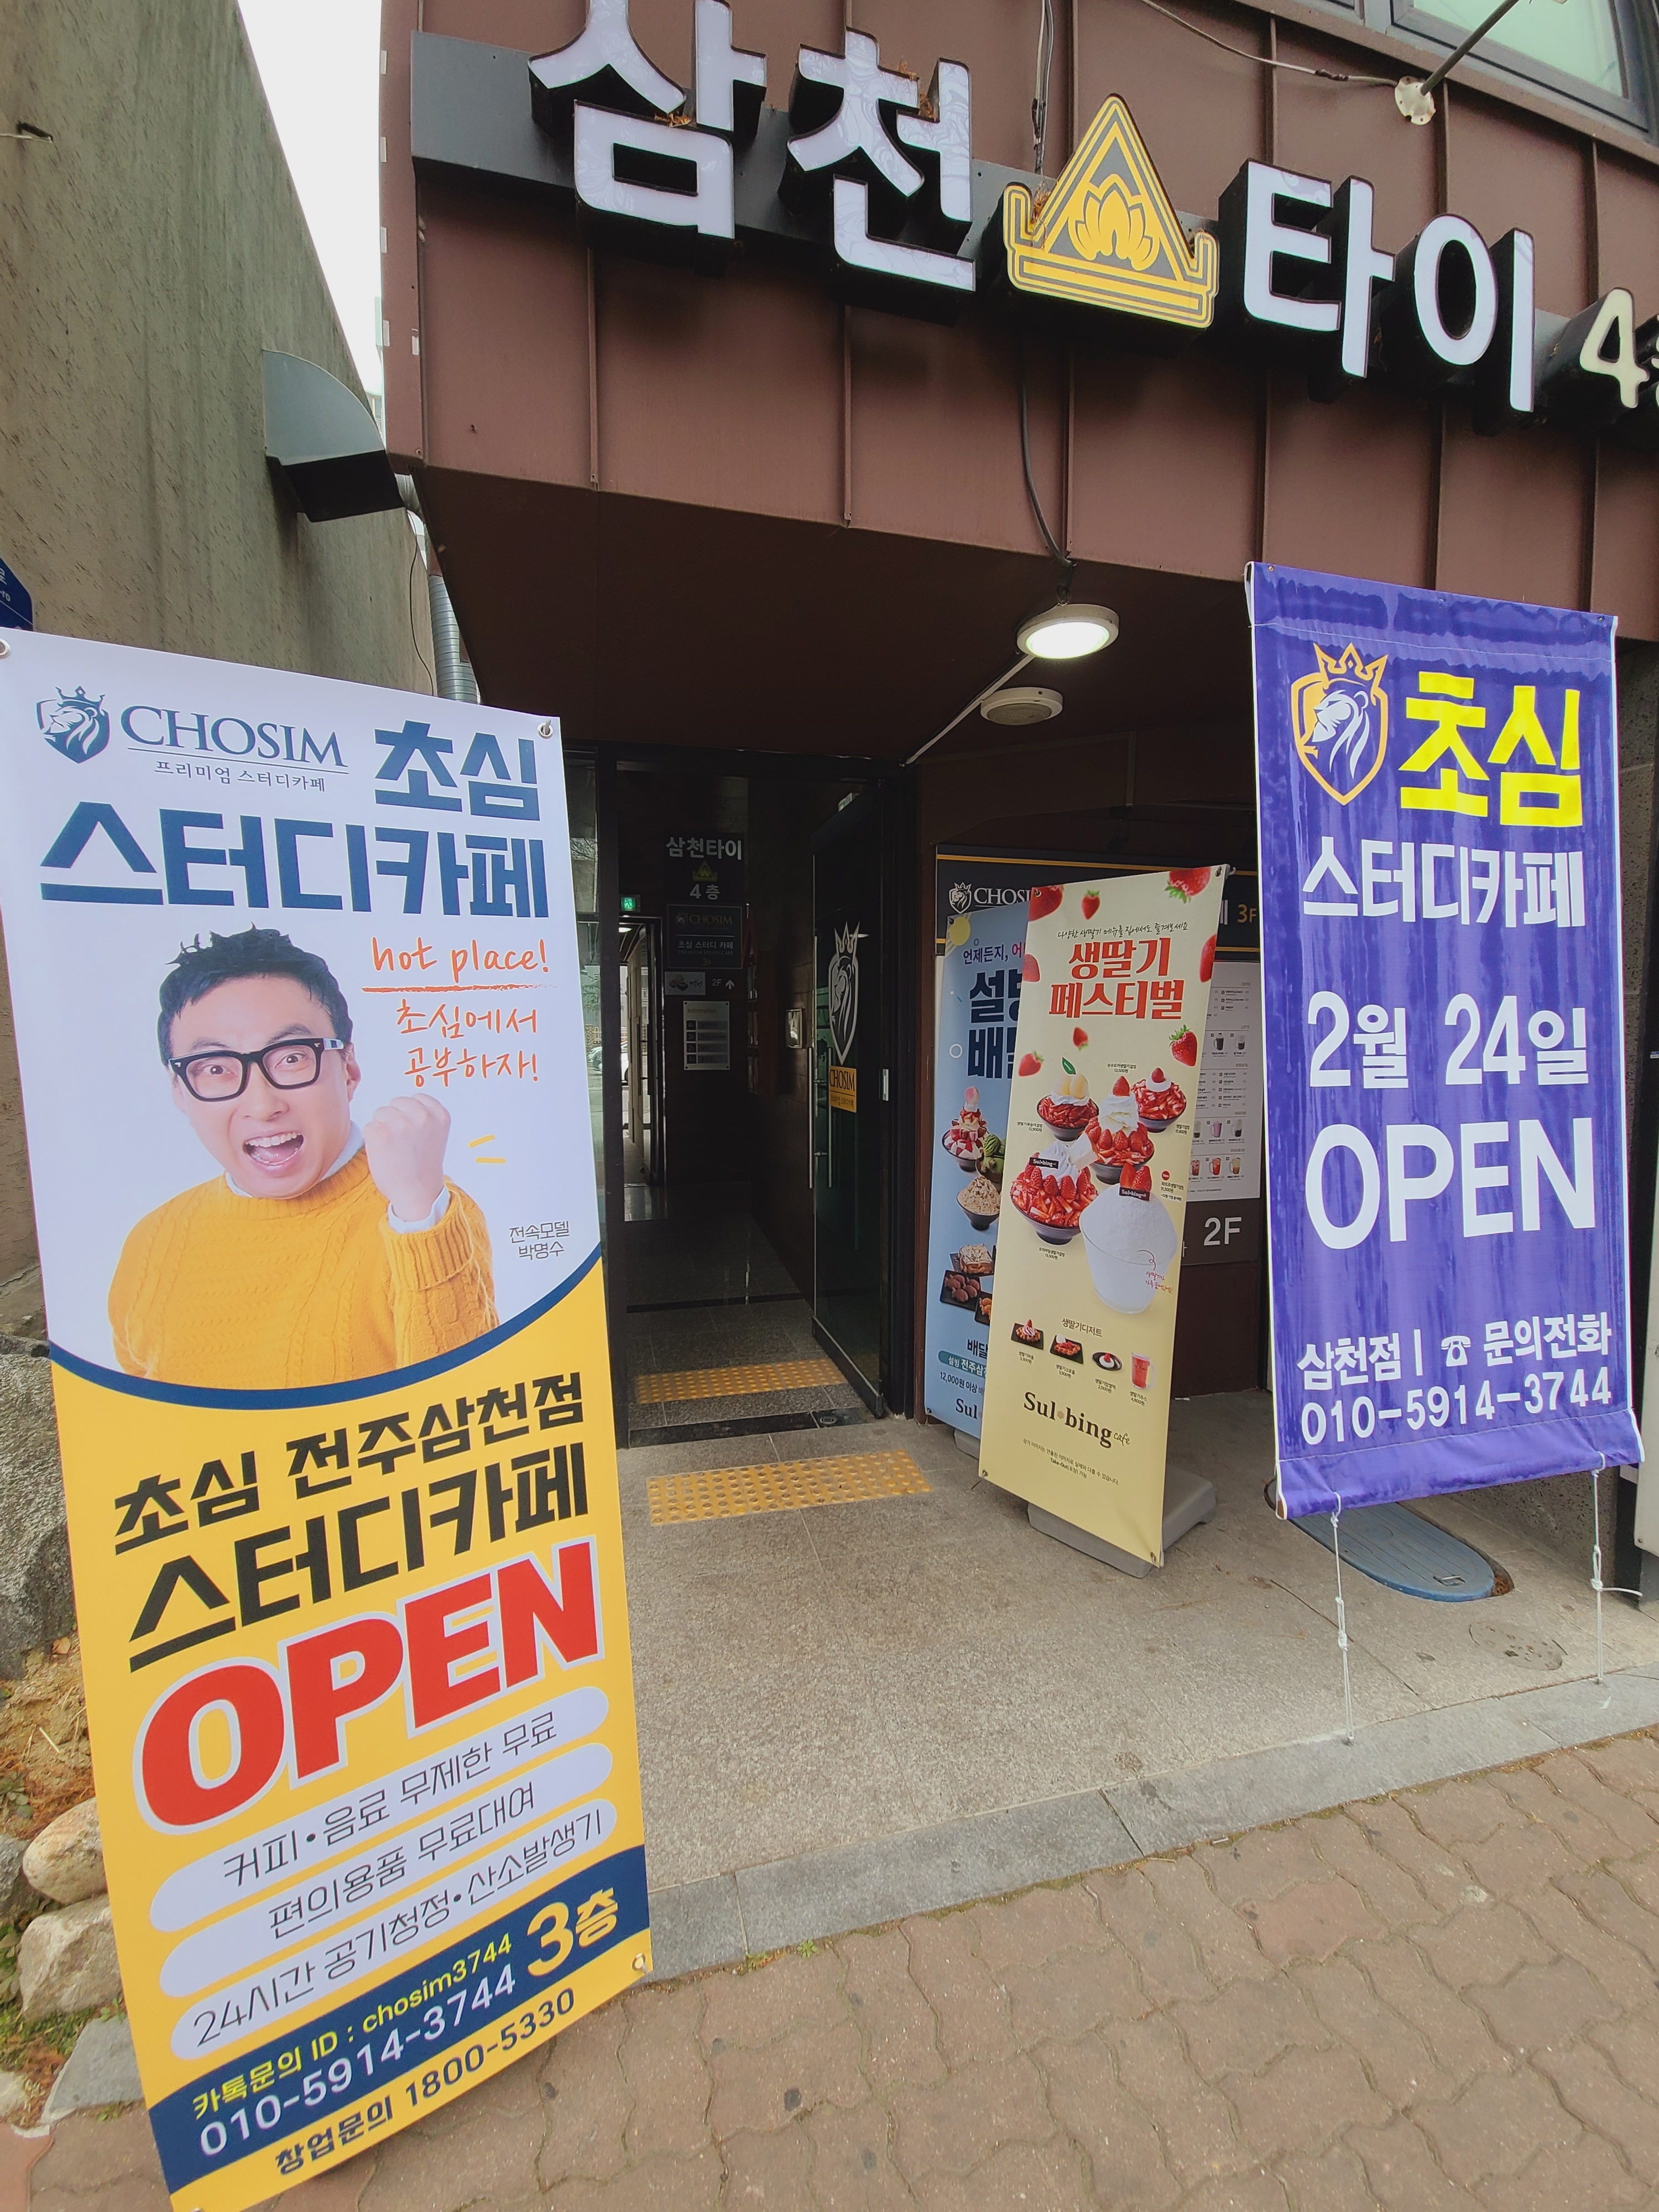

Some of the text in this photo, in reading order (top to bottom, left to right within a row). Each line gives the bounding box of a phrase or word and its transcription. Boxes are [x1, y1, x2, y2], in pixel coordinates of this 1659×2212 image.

[528, 0, 1535, 413] 삼천 타이
[1579, 288, 1659, 409] 4
[120, 705, 348, 768] CHOSIM
[1399, 671, 1583, 827] 초심
[154, 760, 326, 792] 프리미엄 스터디카페
[374, 719, 540, 821] 초심
[40, 801, 549, 919] 스터디카페
[666, 837, 742, 860] 삼천타이
[690, 884, 720, 900] 4 층
[974, 888, 1031, 905] CHOSI
[1302, 837, 1585, 927] 스터디카페
[689, 914, 733, 925] CHOSIM
[1057, 922, 1188, 939] 다양한 생딸기 메뉴를 집에서도 즐겨보세요
[1237, 904, 1257, 923] 3F
[372, 936, 549, 983] hot place!
[677, 941, 692, 949] 초심
[695, 941, 717, 950] 스터디
[963, 944, 1008, 964] 언제든지,
[1068, 937, 1171, 979] 생딸기
[396, 998, 537, 1039] 초심에서
[1048, 979, 1185, 1020] 페스티벌
[1307, 990, 1589, 1088] 2월 24일
[404, 1047, 539, 1088] 공부하자!
[830, 1069, 855, 1091] CHOSIM
[1305, 1118, 1596, 1250] OPEN
[509, 1220, 570, 1244] 전속모델
[518, 1241, 565, 1261] 박명수
[1203, 1217, 1242, 1246] 2F
[1062, 1317, 1103, 1337] 생딸기디저트
[948, 1355, 987, 1378] 설빙 전주삼
[1297, 1311, 1613, 1390] 삼천점 문의전화
[940, 1371, 964, 1389] 12,000원
[966, 1381, 978, 1394] 이상
[1301, 1366, 1612, 1446] 010-5914-3744
[1113, 1432, 1130, 1446] cafe
[114, 1371, 584, 1556] 초심 전주삼천점
[129, 1441, 588, 1673] 스터디카페
[137, 1537, 603, 1830] OPEN
[399, 1741, 493, 1804] 무제한
[502, 1710, 557, 1756] 무료
[267, 1781, 535, 1940] 편의용품 무료대여
[192, 2049, 304, 2121] 카톡문의
[311, 2031, 338, 2063] ID
[362, 1932, 513, 2033] chosim3744
[525, 1886, 619, 1978] 3층
[192, 1960, 316, 2048] 24시간
[199, 1963, 517, 2156] 010-5914-3744
[275, 1987, 575, 2176] 창업문의 1800-5330
